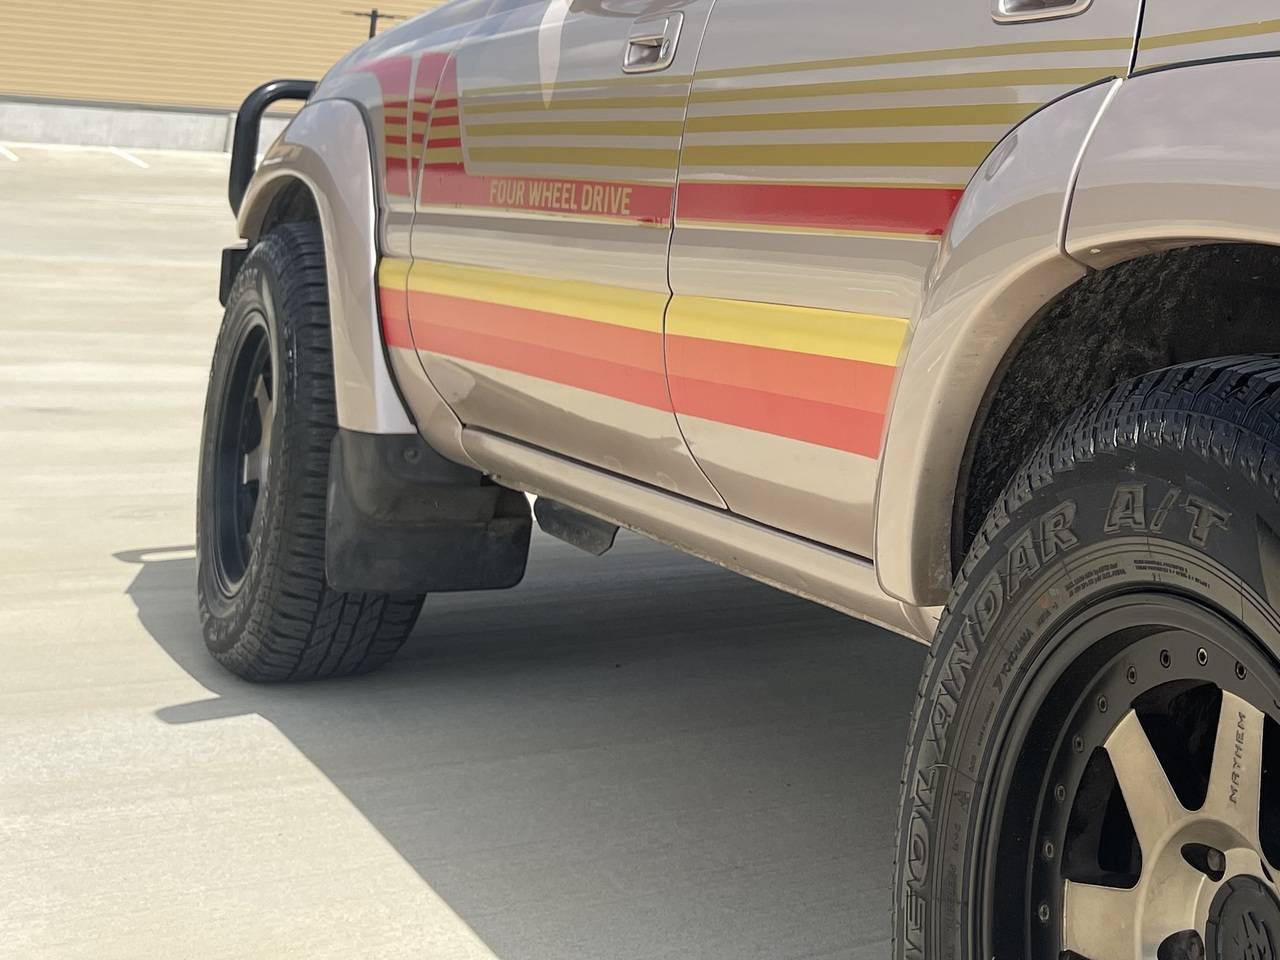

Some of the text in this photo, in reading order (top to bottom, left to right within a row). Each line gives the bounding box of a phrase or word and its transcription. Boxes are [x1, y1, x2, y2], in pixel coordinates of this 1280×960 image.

[490, 179, 632, 215] FOUR WHEEL DRIVE
[903, 499, 1079, 960] EOLANDAR
[1104, 483, 1232, 549] A/T
[1228, 711, 1247, 805] MAYHEM
